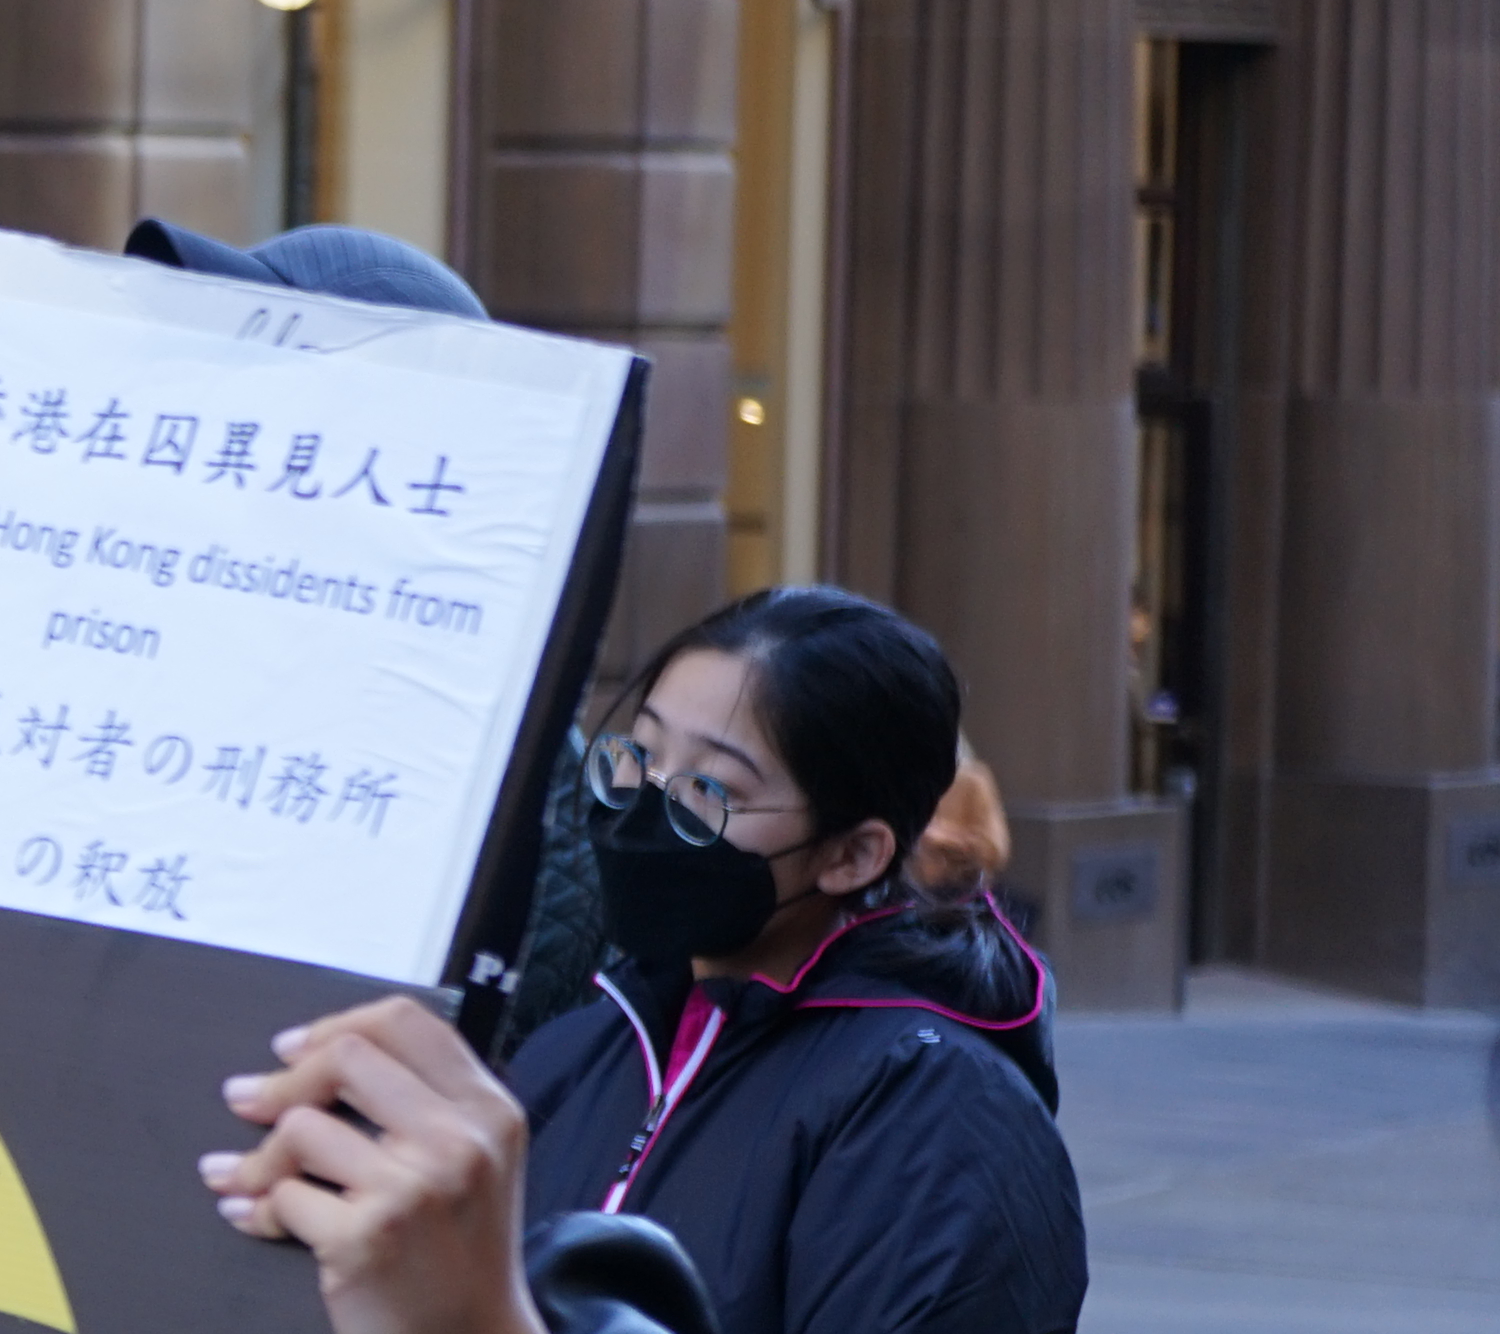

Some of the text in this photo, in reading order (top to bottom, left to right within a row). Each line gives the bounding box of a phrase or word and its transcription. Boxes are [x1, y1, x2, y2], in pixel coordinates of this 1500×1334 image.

[84, 526, 182, 588] Kong
[188, 544, 377, 616] dissidents
[385, 577, 482, 635] from
[41, 607, 162, 659] prison
